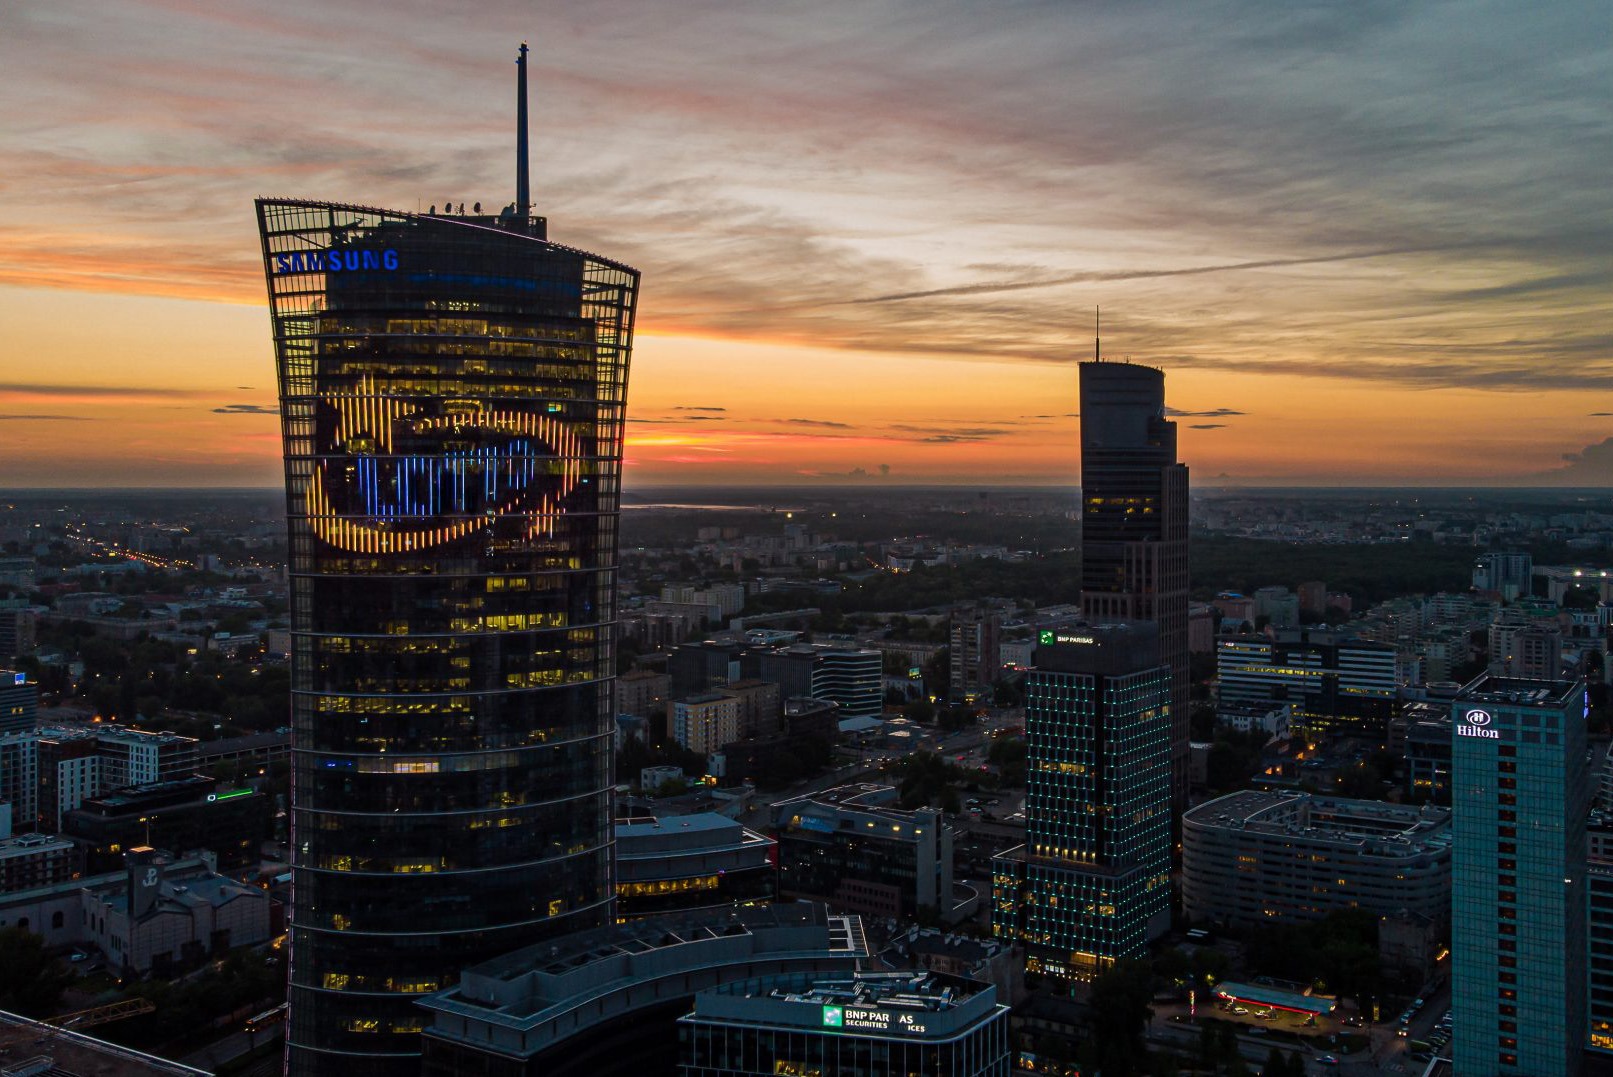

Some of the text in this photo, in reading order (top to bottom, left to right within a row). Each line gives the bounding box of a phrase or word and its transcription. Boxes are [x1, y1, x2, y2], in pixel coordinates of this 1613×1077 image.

[277, 250, 399, 273] SAMSUNG
[1456, 725, 1499, 738] Hilton
[845, 1010, 867, 1020] BNP
[845, 1019, 888, 1029] SECURITIES
